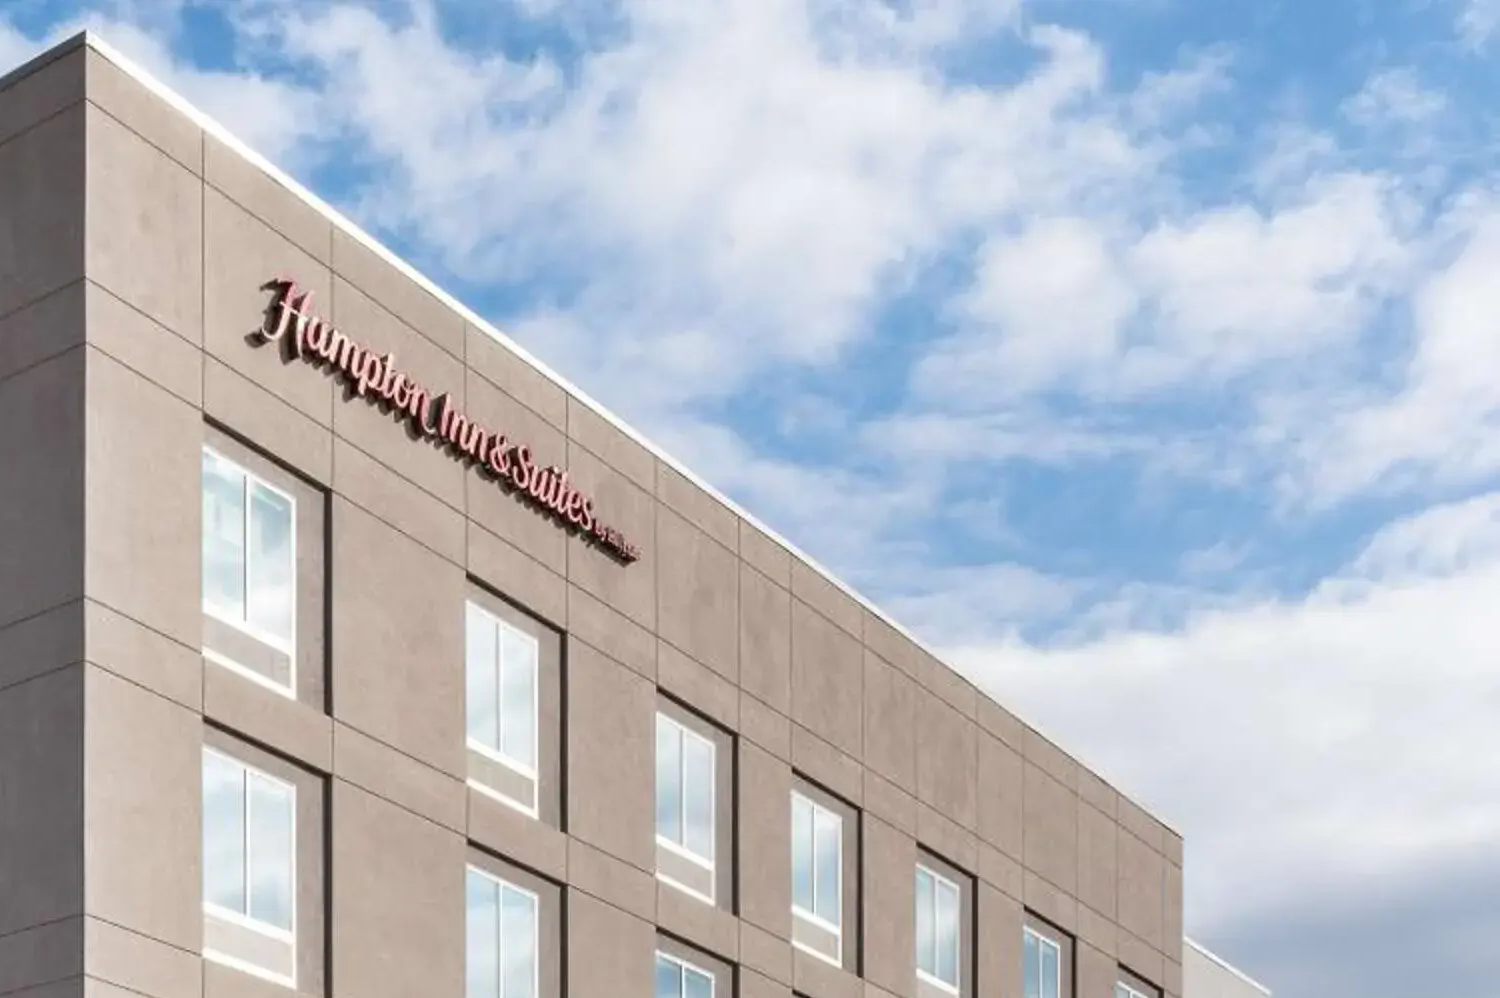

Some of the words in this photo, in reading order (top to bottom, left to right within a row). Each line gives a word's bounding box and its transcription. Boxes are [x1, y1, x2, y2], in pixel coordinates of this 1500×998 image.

[260, 272, 437, 433] Hampton
[440, 392, 488, 462] Inn
[512, 444, 593, 531] Suites
